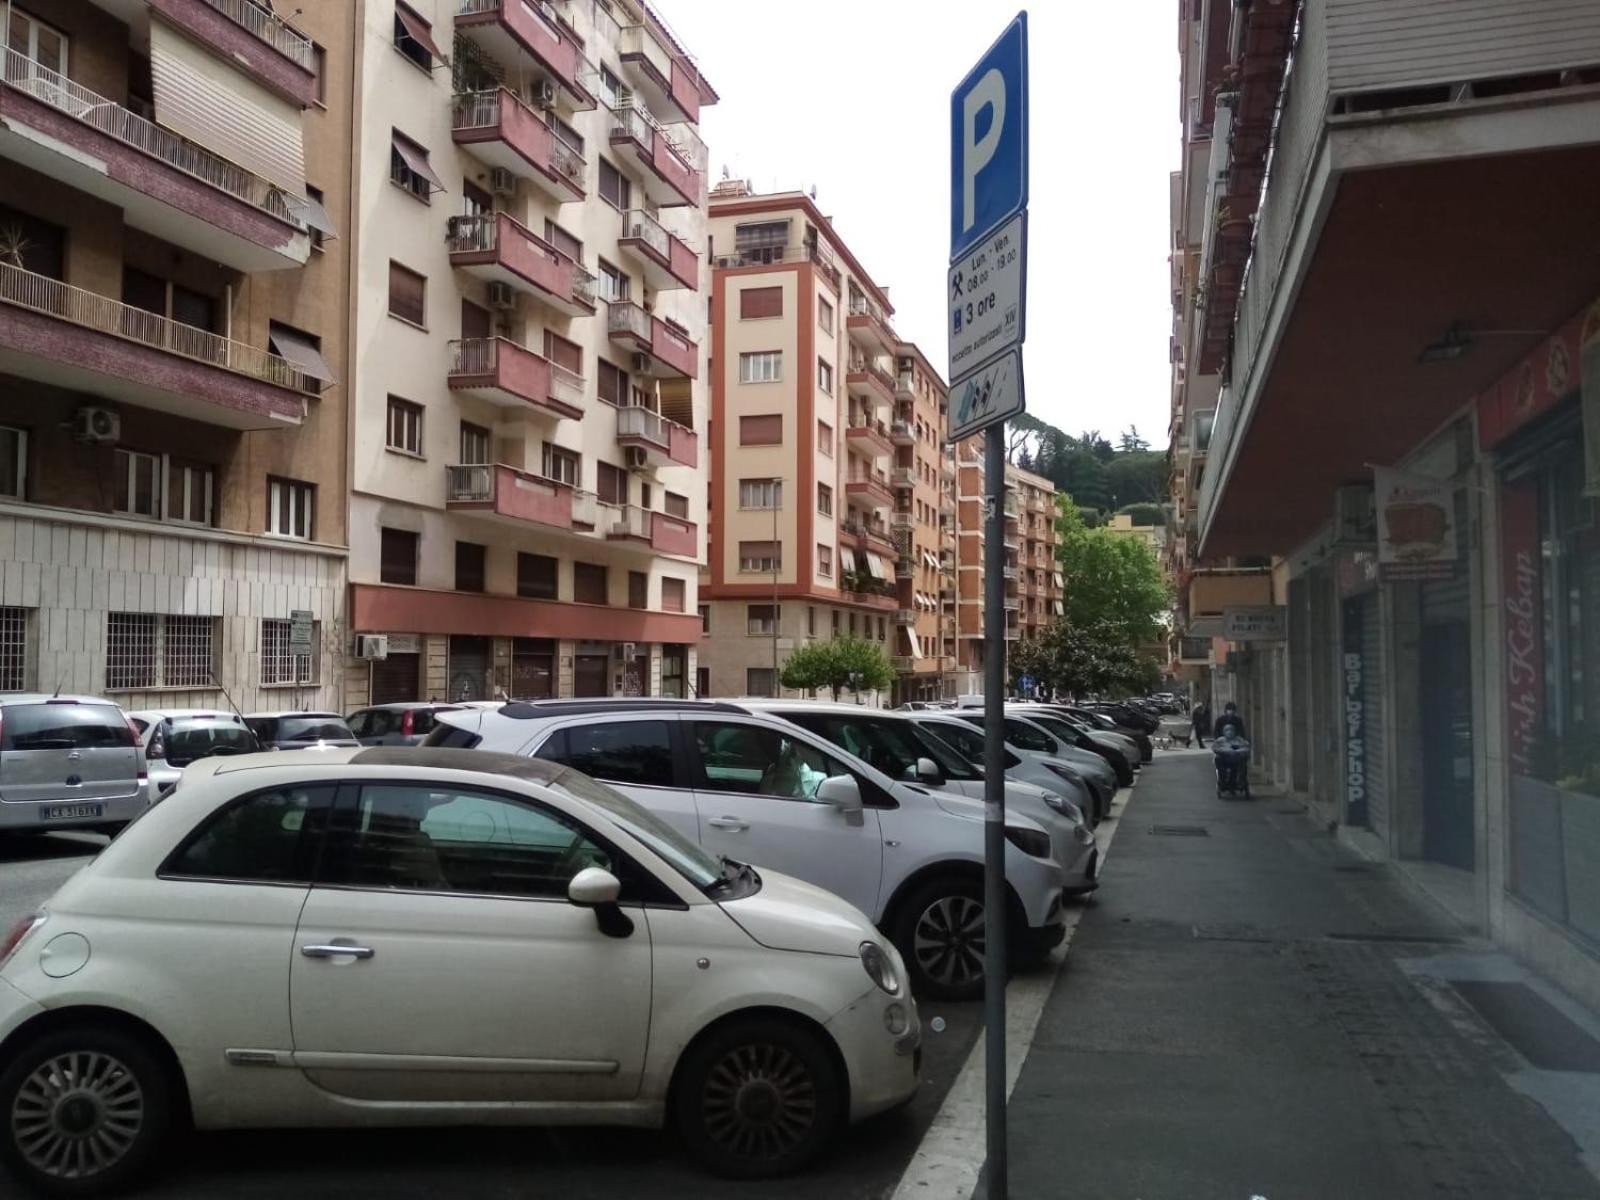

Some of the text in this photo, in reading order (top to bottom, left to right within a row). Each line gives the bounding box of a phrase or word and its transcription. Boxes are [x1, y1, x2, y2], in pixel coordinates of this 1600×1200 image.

[963, 68, 1006, 233] P
[966, 292, 995, 325] 3 ore
[1506, 550, 1536, 685] Kebap
